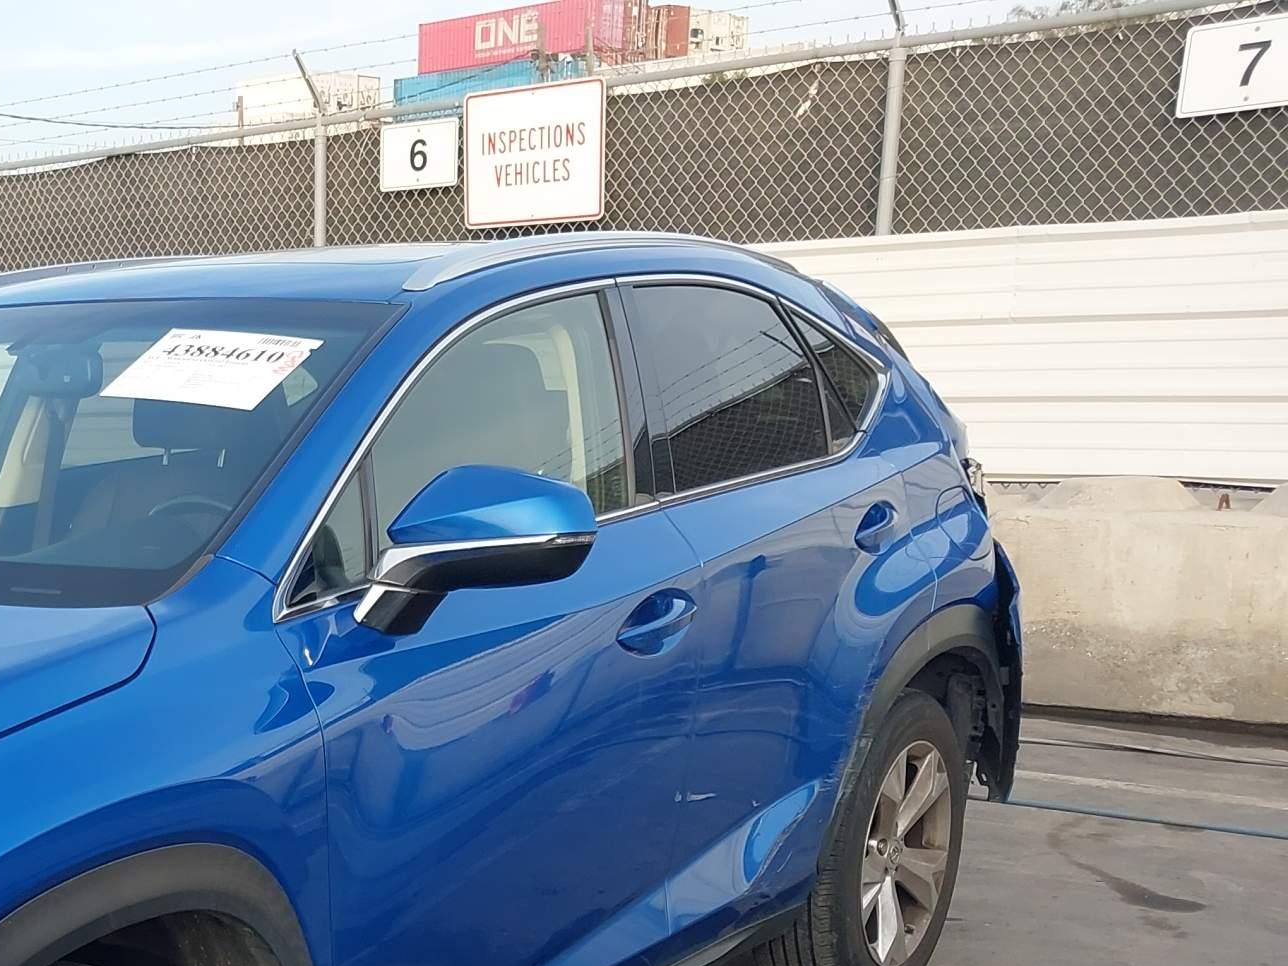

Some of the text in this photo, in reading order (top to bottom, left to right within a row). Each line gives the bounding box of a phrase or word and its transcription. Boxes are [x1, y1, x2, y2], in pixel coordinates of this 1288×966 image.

[474, 12, 538, 50] ONE
[1238, 40, 1273, 87] 7
[409, 139, 428, 172] 6
[481, 122, 586, 156] INSPECTIONS
[494, 158, 571, 188] VEHICLES
[163, 343, 285, 363] 43884610
